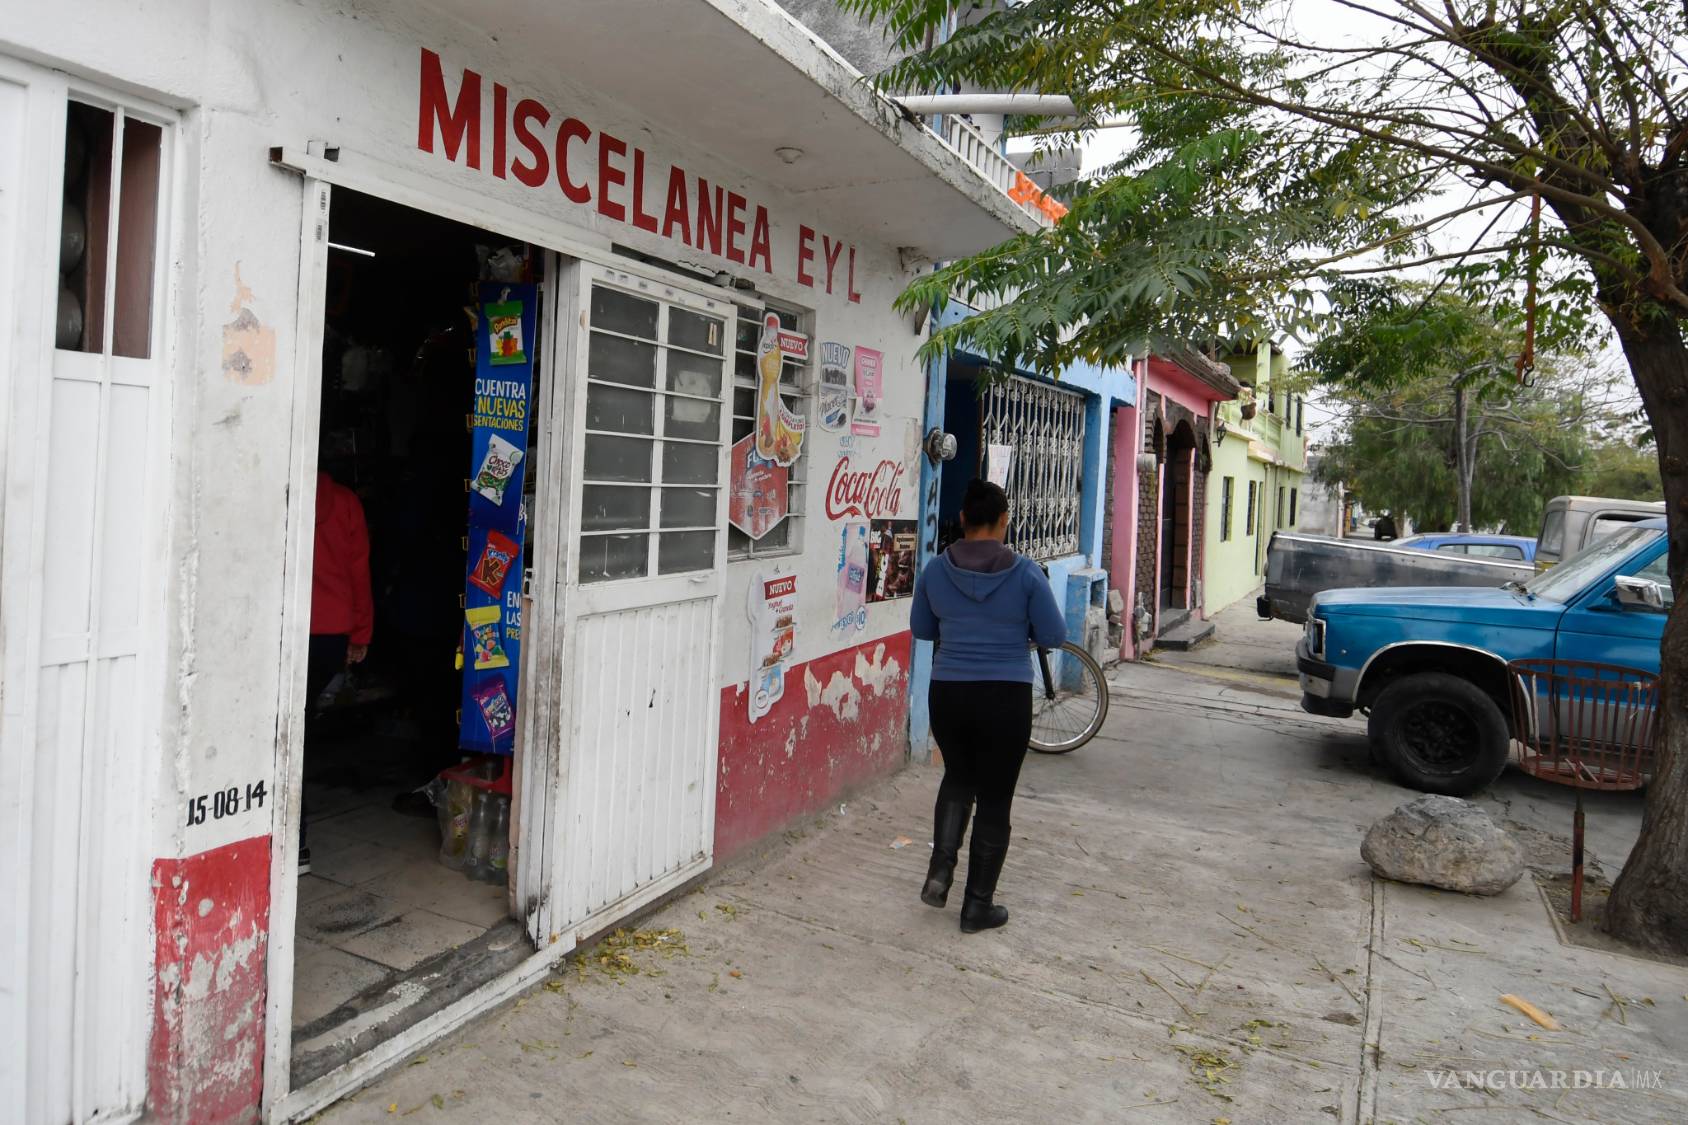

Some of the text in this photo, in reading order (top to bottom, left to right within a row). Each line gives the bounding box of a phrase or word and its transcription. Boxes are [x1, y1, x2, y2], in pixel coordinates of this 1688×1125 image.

[417, 47, 861, 304] MISCELANEA EYL
[780, 336, 804, 351] NUEVO
[821, 342, 850, 370] NUEVO
[478, 396, 526, 419] NUEVAS
[769, 580, 793, 596] NUEVO
[506, 591, 521, 609] EN
[186, 780, 268, 827] 15-08-14
